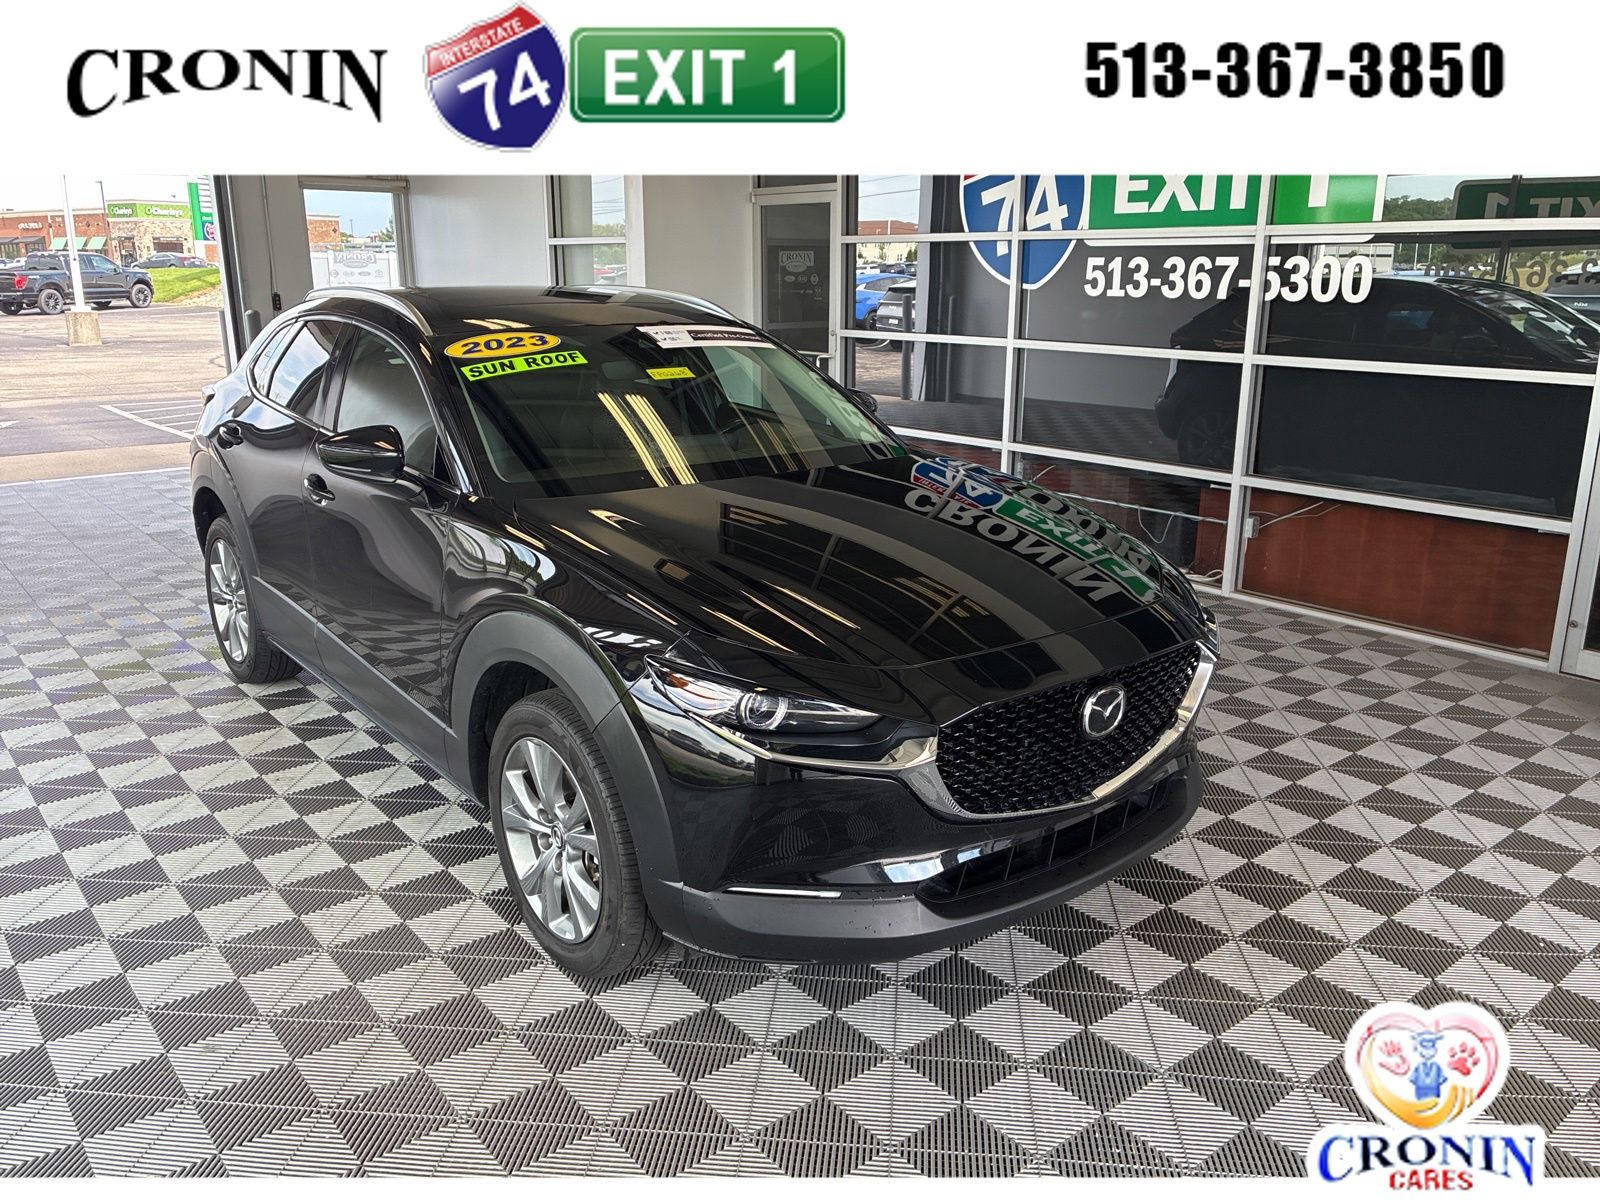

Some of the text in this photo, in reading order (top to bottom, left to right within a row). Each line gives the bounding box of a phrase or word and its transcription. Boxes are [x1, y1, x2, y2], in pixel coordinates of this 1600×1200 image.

[981, 174, 1069, 257] 74
[1083, 255, 1373, 304] 513-367-5300
[460, 335, 549, 356] 2023
[468, 351, 580, 378] SUN ROOF
